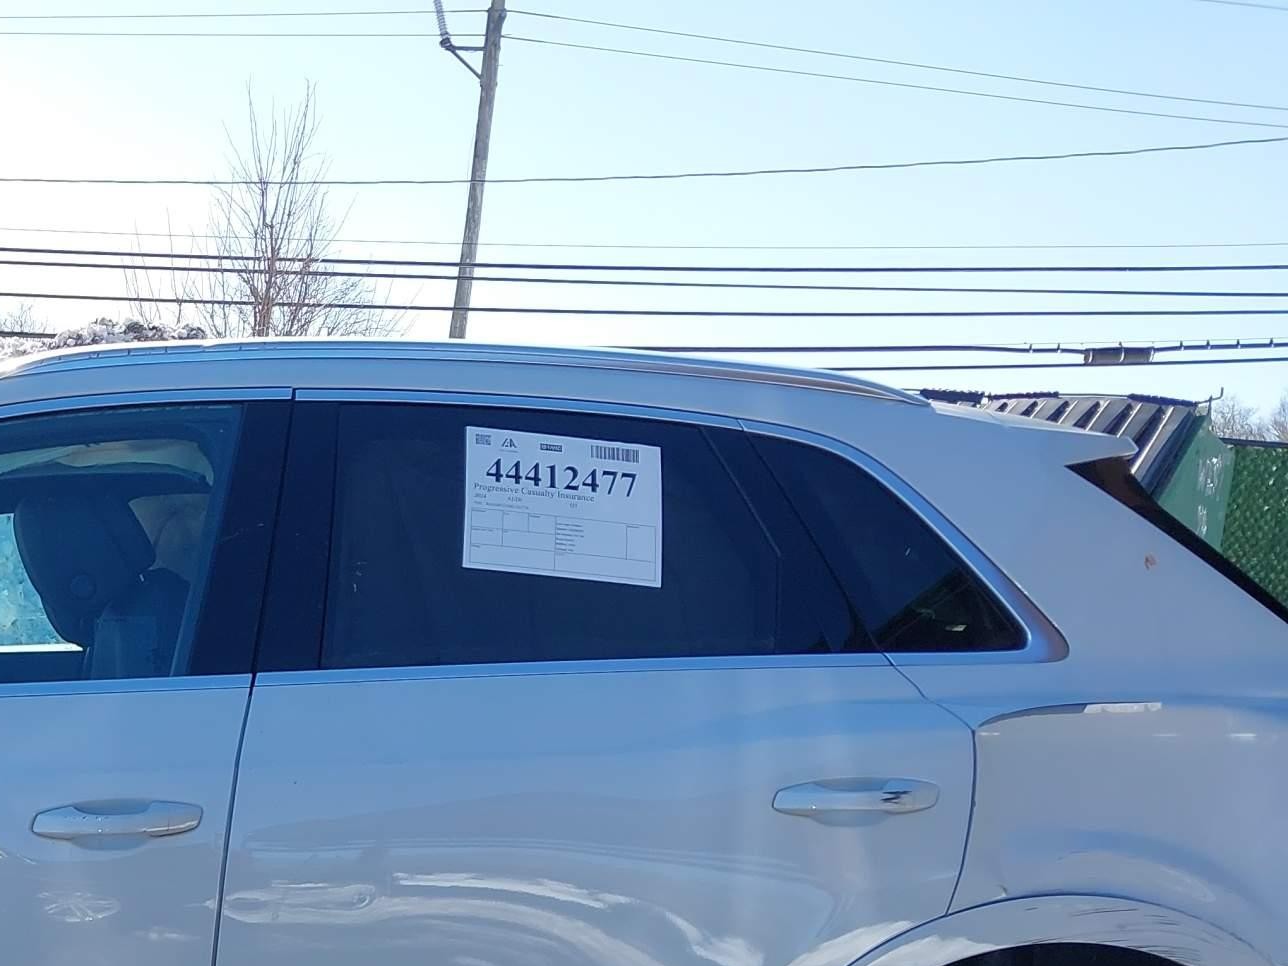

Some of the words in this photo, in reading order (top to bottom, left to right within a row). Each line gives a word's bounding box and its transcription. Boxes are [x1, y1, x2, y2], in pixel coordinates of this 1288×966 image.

[474, 482, 520, 495] Progressive
[521, 487, 555, 499] Casualty
[557, 490, 595, 502] Insurance
[486, 458, 637, 497] 44412477
